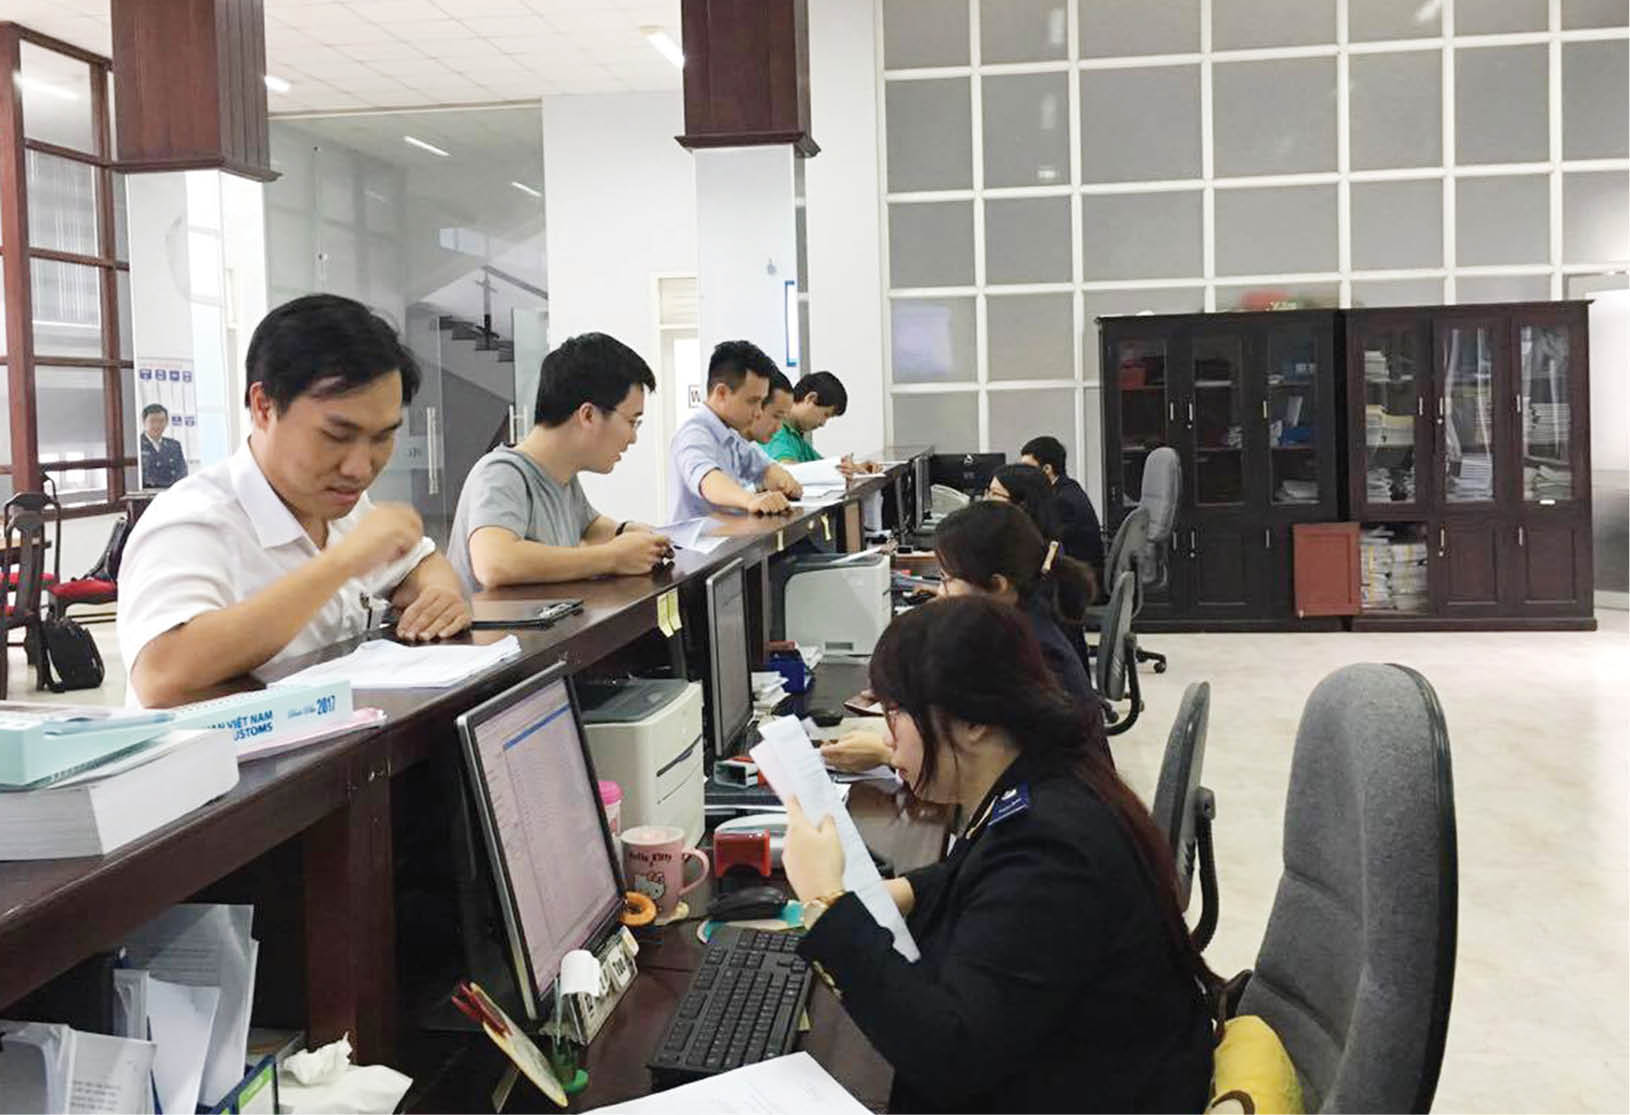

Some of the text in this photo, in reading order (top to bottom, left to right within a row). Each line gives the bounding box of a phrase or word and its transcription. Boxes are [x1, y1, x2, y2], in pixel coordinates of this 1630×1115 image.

[317, 695, 336, 715] 2017
[250, 710, 273, 724] NAM
[234, 722, 273, 741] USTOMS
